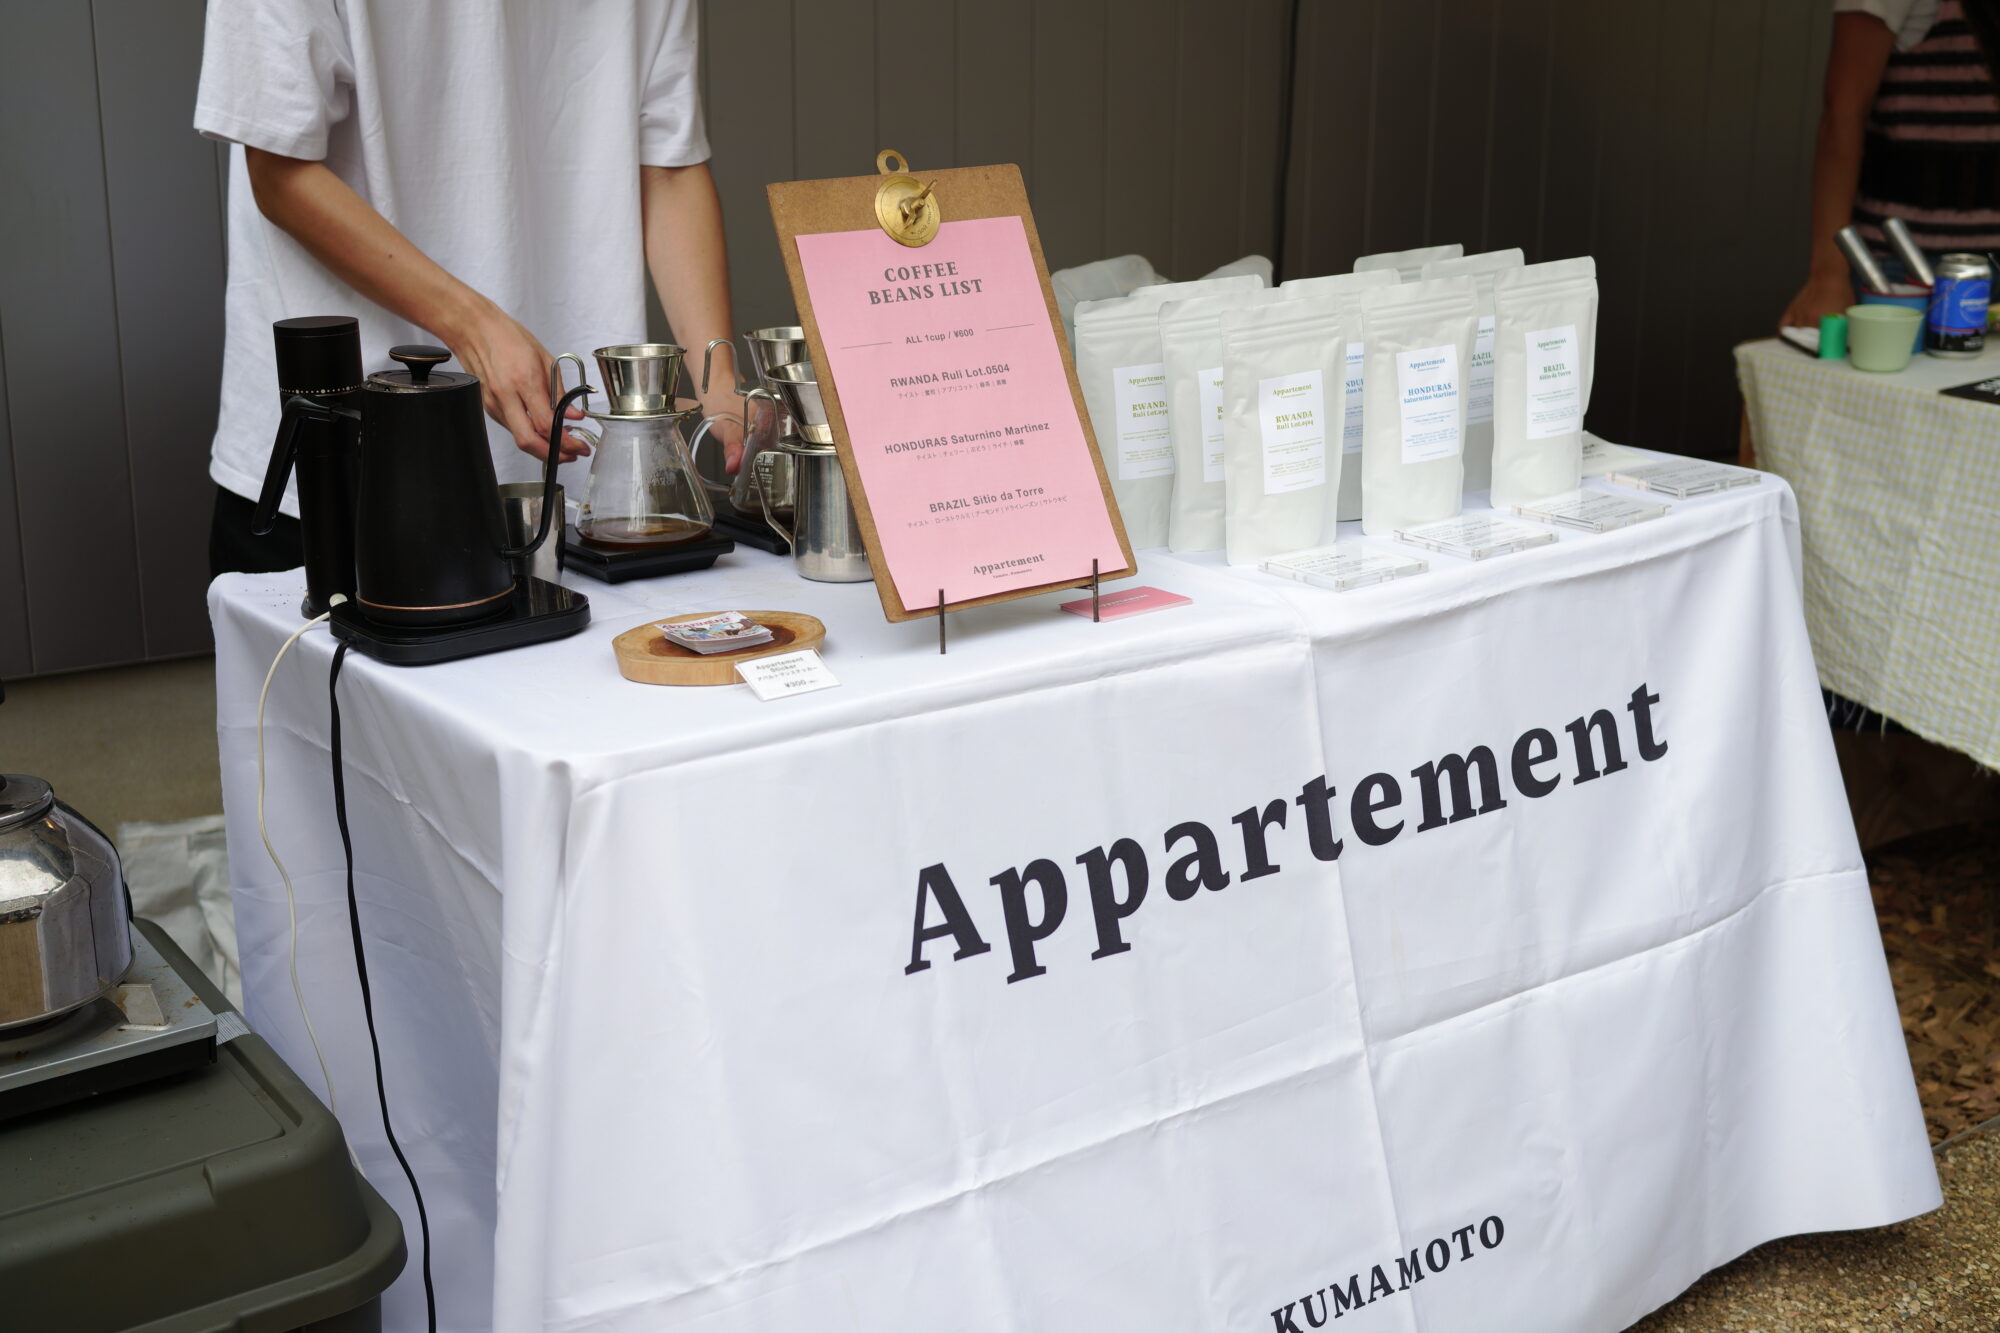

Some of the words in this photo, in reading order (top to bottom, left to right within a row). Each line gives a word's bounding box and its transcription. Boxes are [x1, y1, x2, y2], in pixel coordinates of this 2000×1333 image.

[884, 261, 959, 282] COFFEE
[868, 284, 934, 305] BEANS
[939, 278, 983, 297] LIST
[905, 336, 923, 344] ALL
[925, 333, 946, 342] 1cup
[953, 328, 974, 338] ¥600
[1408, 357, 1446, 369] Appartement
[1543, 362, 1566, 373] BRAZIL
[890, 373, 939, 388] RWANDA
[941, 370, 963, 381] Ruli
[965, 363, 1010, 378] Lot.0504
[1272, 383, 1313, 397] Appartement
[1408, 382, 1453, 396] HONDURAS
[1132, 400, 1168, 412] RWAND
[1275, 410, 1313, 424] RWANDA
[884, 436, 948, 454] HONDURAS
[951, 429, 1002, 445] Saturnino
[1004, 422, 1050, 436] Martinez
[929, 498, 970, 513] BRAZIL
[973, 494, 997, 506] Sitio
[1000, 490, 1014, 502] da
[1015, 486, 1044, 499] Torre
[973, 553, 1045, 575] Appartement
[904, 682, 1669, 986] Appartement
[1270, 1215, 1505, 1333] KUMAMOTO
